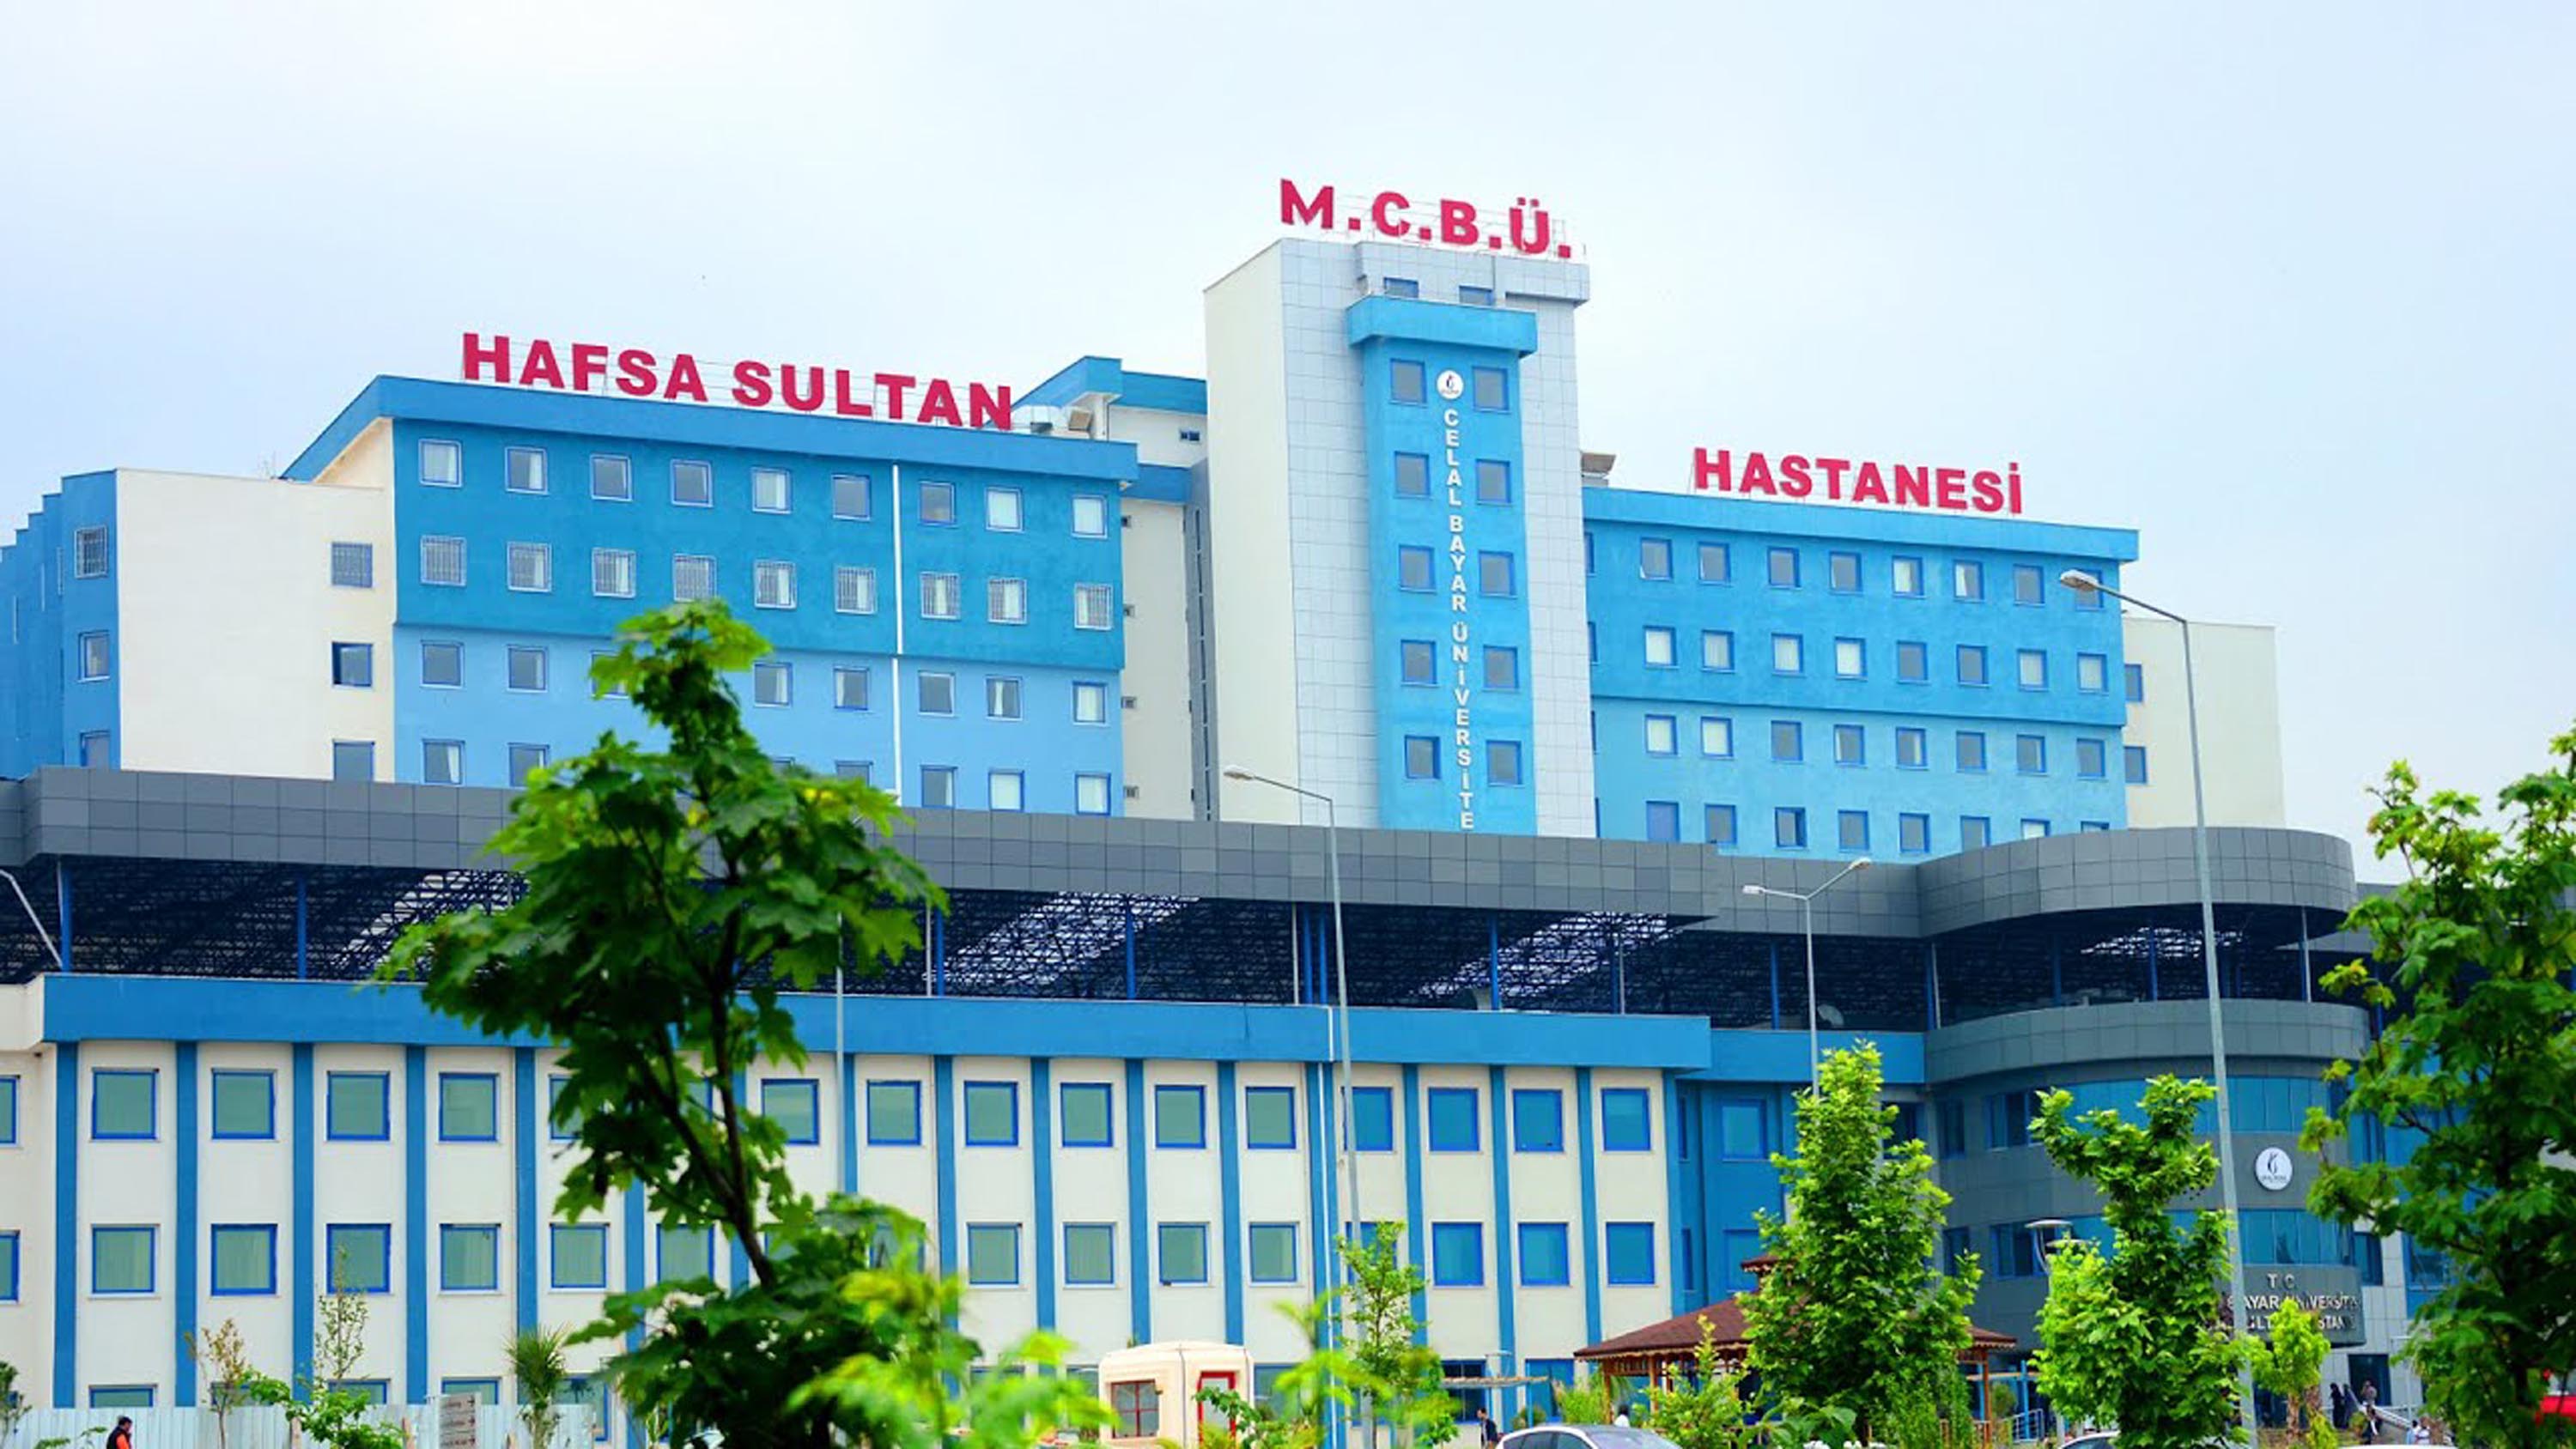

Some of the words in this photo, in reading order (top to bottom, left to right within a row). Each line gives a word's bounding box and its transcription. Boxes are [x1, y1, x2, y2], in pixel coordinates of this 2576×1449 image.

[1279, 178, 1572, 259] M.C.B.Ü.
[462, 332, 708, 403] HAFSA
[732, 361, 1012, 431] SULTAN
[1443, 408, 1462, 506] CELAL
[1693, 447, 2023, 514] HASTANESİ
[1449, 514, 1467, 612] BAYAR
